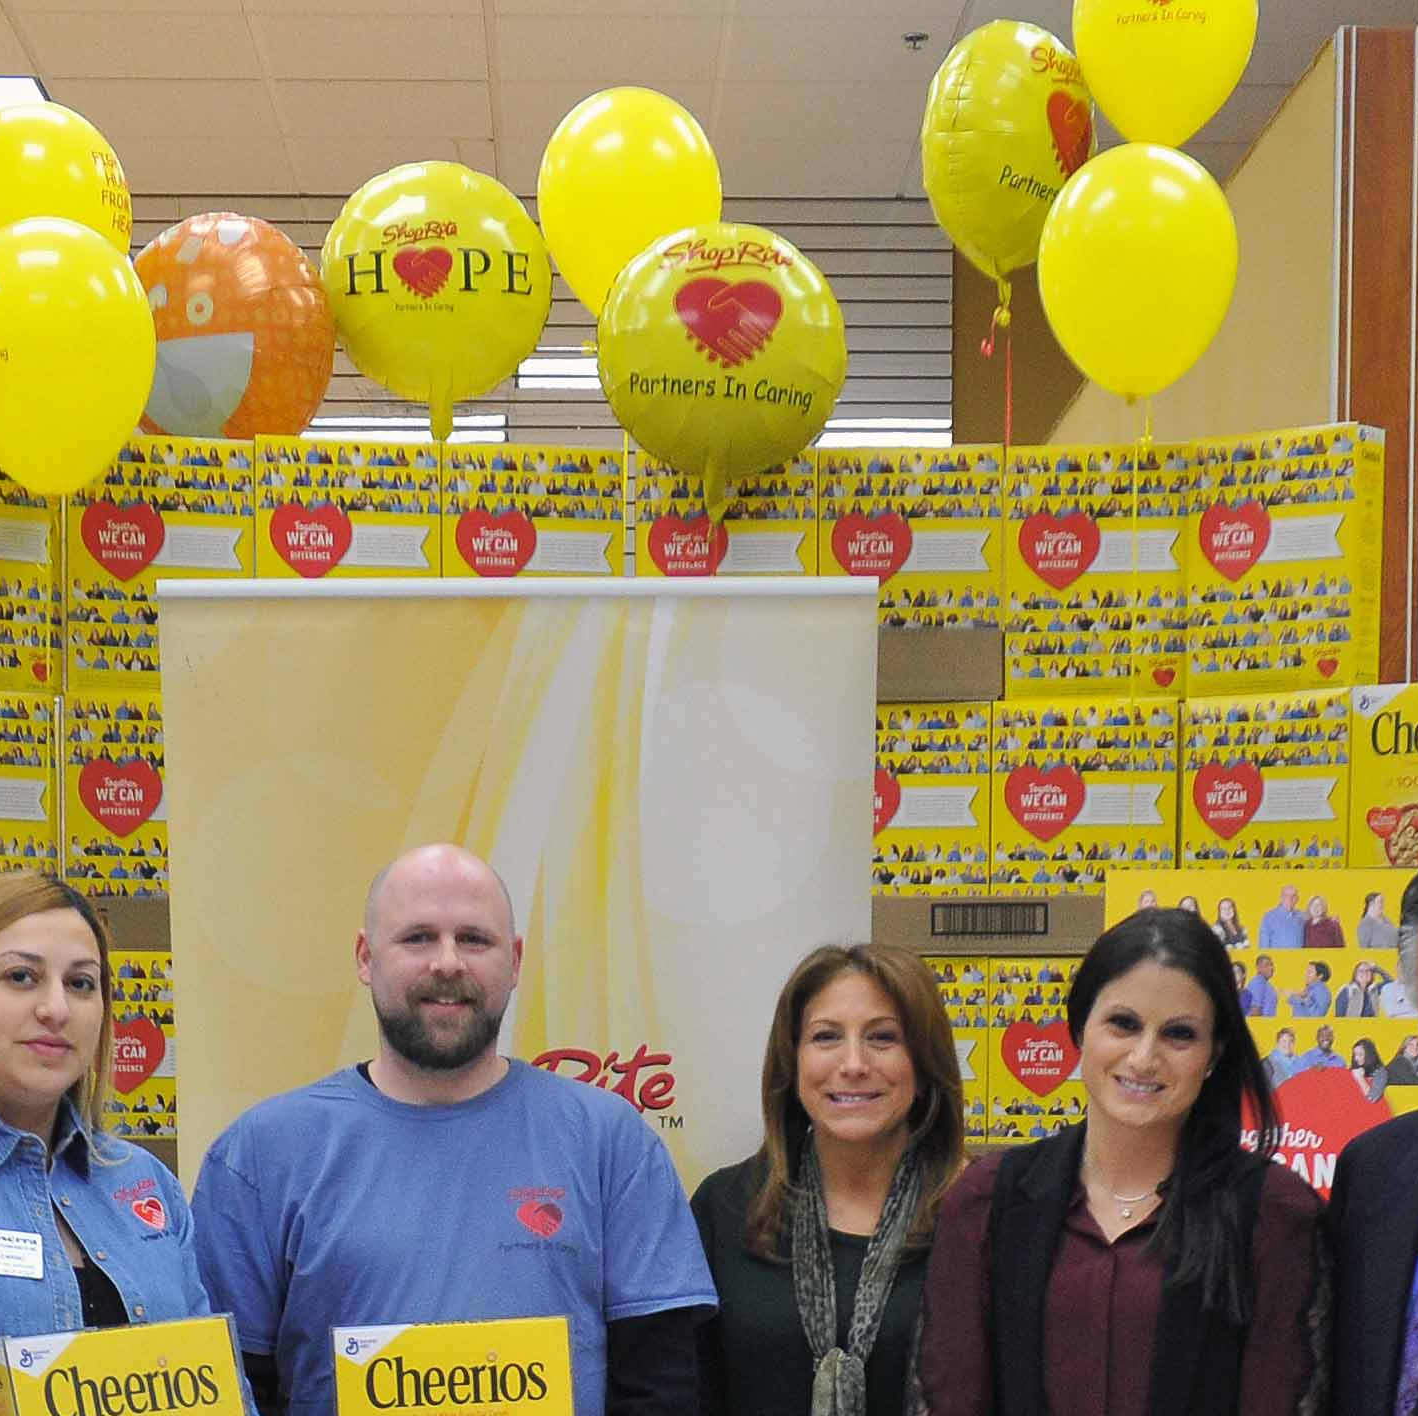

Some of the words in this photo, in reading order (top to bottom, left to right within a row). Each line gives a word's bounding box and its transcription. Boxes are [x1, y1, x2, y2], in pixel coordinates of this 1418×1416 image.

[381, 220, 458, 247] ShopRite
[630, 372, 716, 398] Partners
[723, 375, 748, 400] In
[754, 379, 814, 416] Caring
[98, 530, 120, 545] WE
[123, 531, 147, 546] CAN
[286, 532, 306, 546] WE
[309, 532, 334, 547] CAN
[471, 537, 492, 552] WE
[495, 537, 519, 552] CAN
[1212, 532, 1230, 546] WE
[1233, 531, 1255, 545] CAN
[663, 542, 683, 556] WE
[686, 542, 710, 556] CAN
[847, 541, 868, 556] WE
[871, 541, 894, 555] CAN
[1035, 540, 1054, 556] WE
[1057, 540, 1082, 554] CAN
[96, 787, 117, 802] WE
[119, 787, 144, 802] CAN
[1021, 793, 1040, 808] WE
[1043, 793, 1067, 807] CAN
[1205, 791, 1224, 806] WE
[1227, 790, 1248, 804] CAN
[122, 1045, 148, 1060] CAN
[1017, 1048, 1037, 1063] WE
[1039, 1048, 1064, 1062] CAN
[658, 1115, 684, 1129] TM
[366, 1356, 548, 1409] Cheerios
